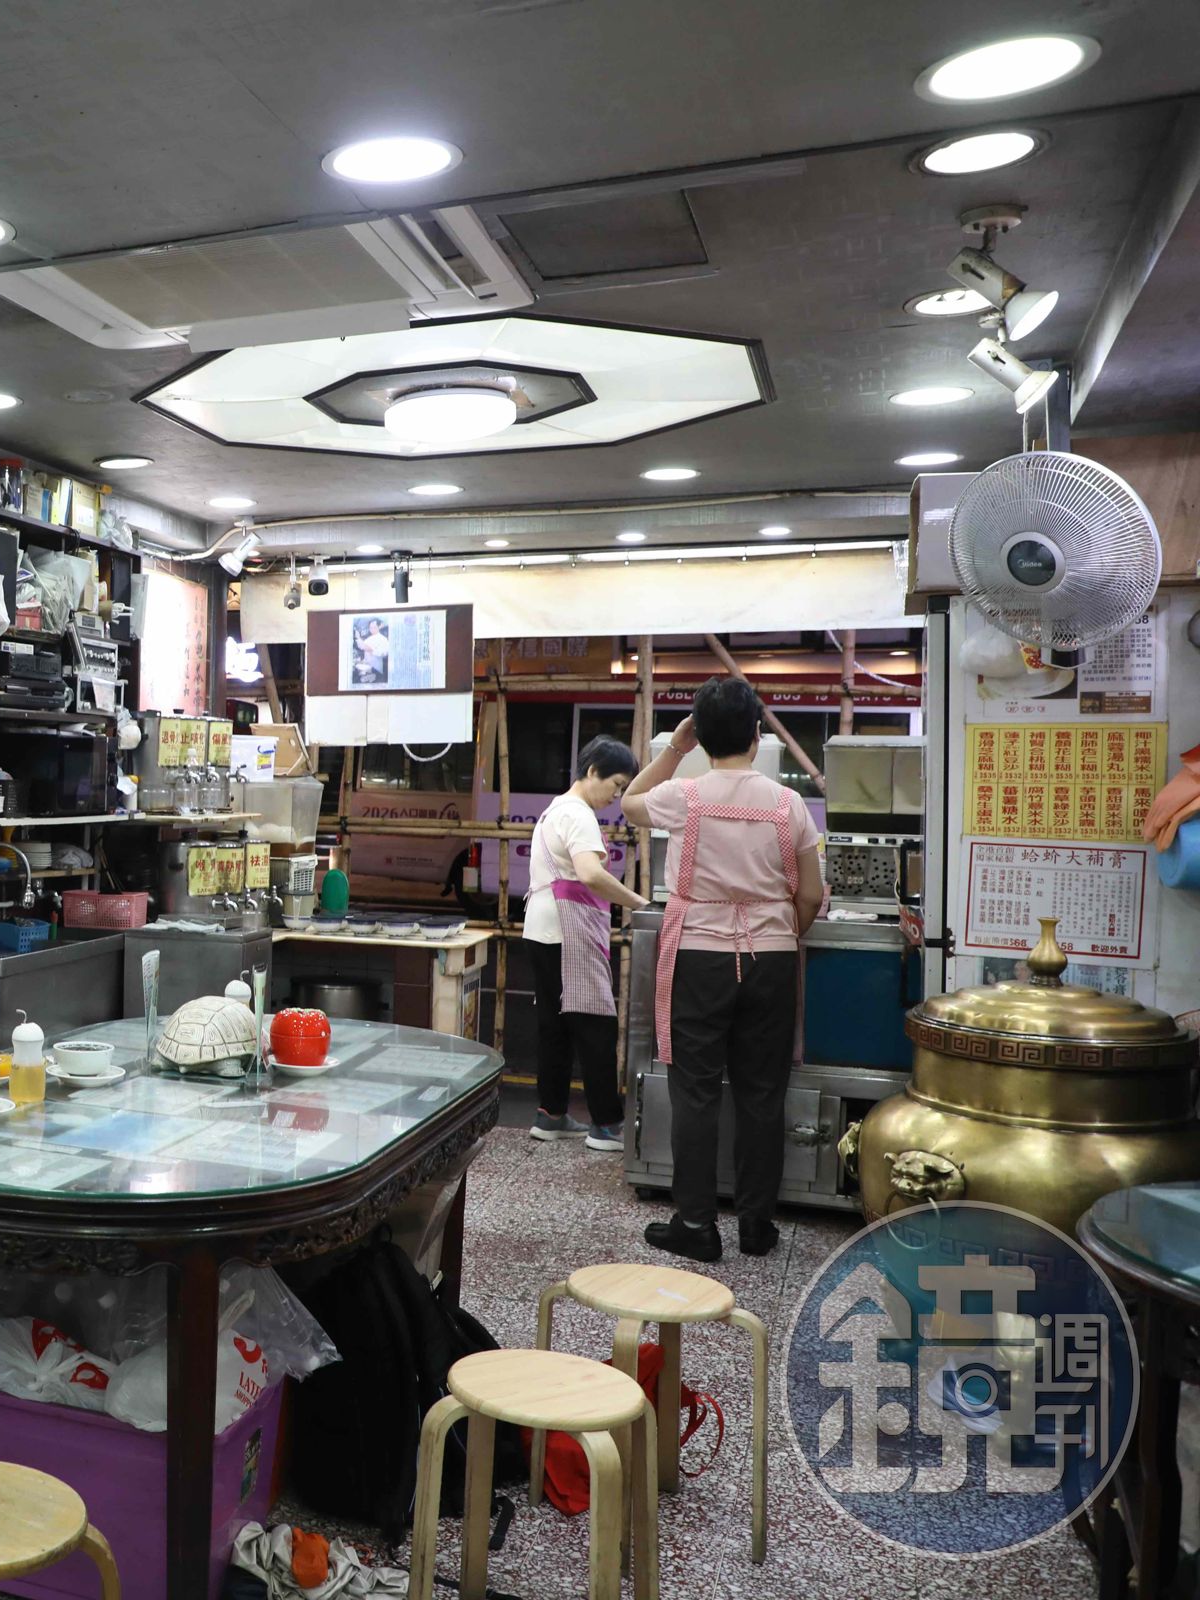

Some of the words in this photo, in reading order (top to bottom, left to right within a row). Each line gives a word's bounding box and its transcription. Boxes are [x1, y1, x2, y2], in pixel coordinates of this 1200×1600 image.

[1017, 560, 1042, 568] Midea
[1021, 849, 1127, 869] 蛤蚧大補膏
